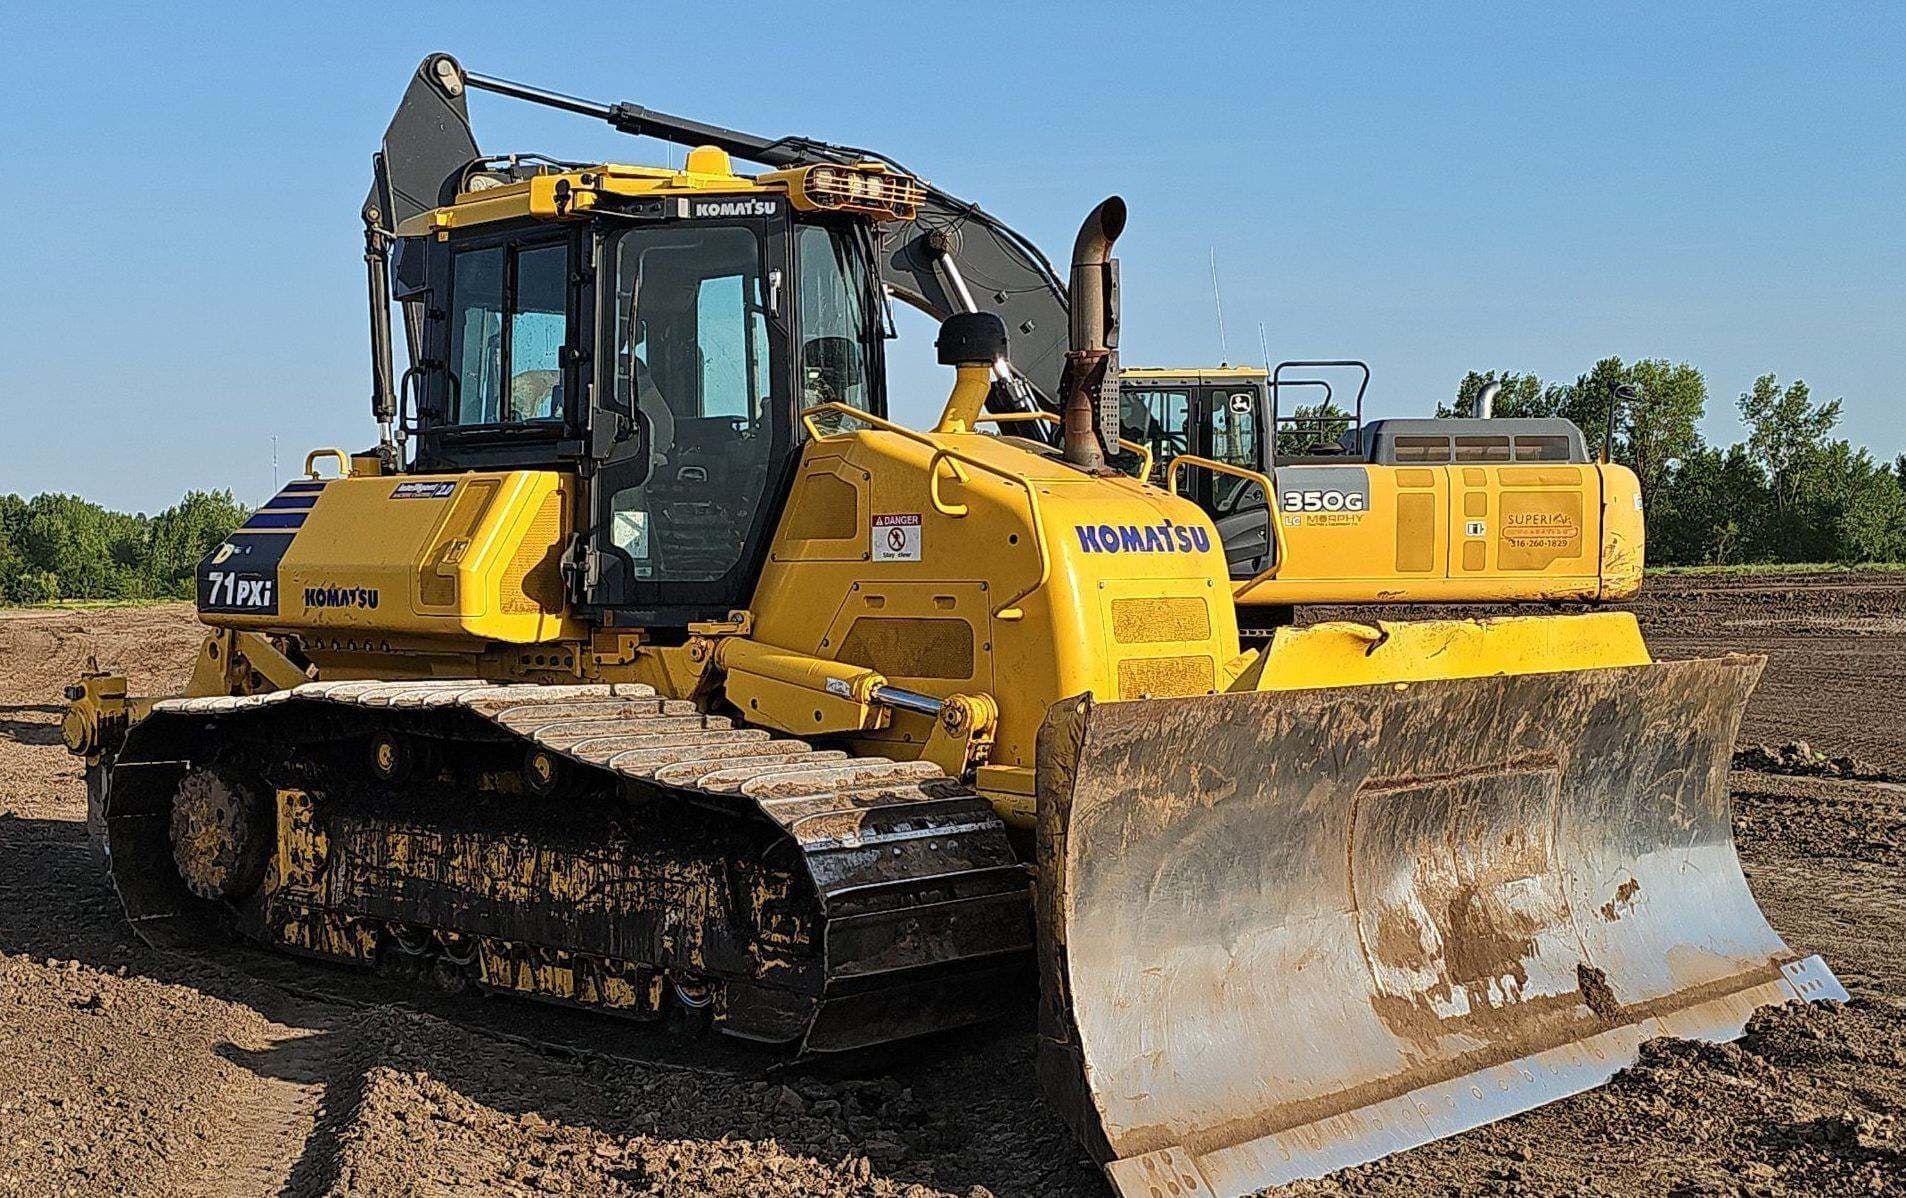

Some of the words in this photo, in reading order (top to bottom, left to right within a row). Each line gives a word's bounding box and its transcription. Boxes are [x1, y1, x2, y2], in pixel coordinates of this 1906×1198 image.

[696, 198, 776, 217] KOMATSU
[1283, 489, 1365, 512] 350G
[884, 515, 919, 525] DANGER
[1284, 516, 1302, 527] LC
[1074, 518, 1211, 553] KOMATSU
[208, 571, 272, 607] 71PXi
[304, 586, 379, 609] KOMATSU
